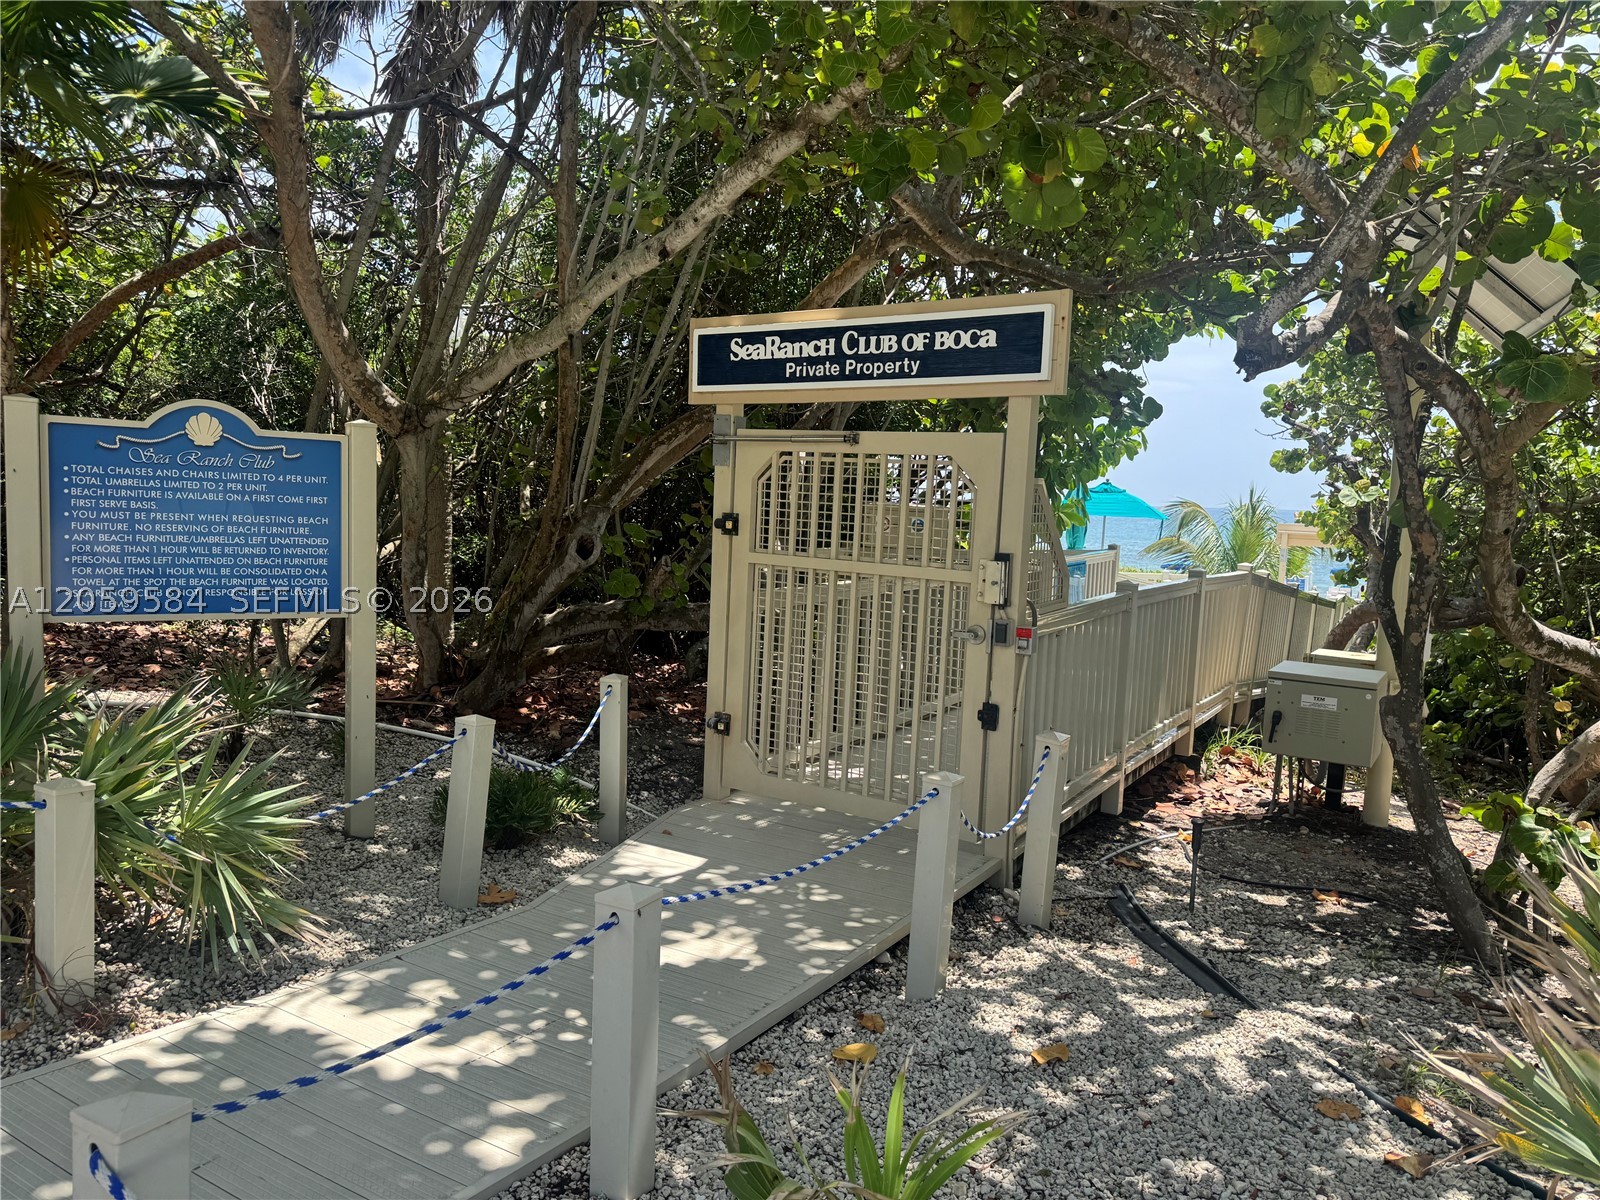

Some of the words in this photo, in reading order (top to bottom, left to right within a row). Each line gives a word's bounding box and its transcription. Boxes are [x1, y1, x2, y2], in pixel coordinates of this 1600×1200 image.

[902, 332, 931, 352] OF
[785, 361, 840, 378] Private
[845, 358, 920, 377] Property
[128, 447, 172, 464] Sea
[177, 450, 233, 467] Ranch
[238, 453, 275, 469] Club
[71, 464, 105, 474] TOTAL
[107, 466, 153, 476] CHAISES
[155, 469, 179, 477] AND
[182, 470, 219, 479] CHAIRS
[222, 472, 260, 481] LIMITED
[262, 474, 276, 482] TO
[286, 475, 302, 483] PER
[304, 476, 328, 484] UNIT.
[71, 476, 102, 485] TOTAL
[105, 478, 161, 488] UMBRELLAS
[164, 481, 200, 489] LIMITED
[202, 482, 215, 490] TO
[218, 482, 224, 490] 2
[227, 483, 242, 491] PER
[245, 484, 268, 492] UNIT.
[71, 488, 105, 497] BEACH
[108, 489, 162, 498] FURNITURE
[165, 491, 173, 499] IS
[175, 491, 224, 500] AVAILABLE
[226, 493, 241, 501] ON
[243, 494, 251, 502] A
[252, 494, 274, 503] FIRST
[277, 495, 304, 504] COME
[306, 496, 328, 505] FIRST
[71, 499, 96, 507] FIRST
[99, 500, 127, 508] SERVE
[130, 500, 159, 509] BASIS.
[72, 510, 96, 519] YOU
[100, 511, 131, 519] MUST
[134, 511, 146, 520] BE
[150, 512, 194, 521] PRESENT
[198, 514, 229, 522] WHEN
[232, 514, 294, 524] REQUESTING
[297, 516, 329, 525] BEACH
[71, 522, 132, 531] FURNITURE.
[135, 523, 152, 531] NO
[155, 524, 208, 533] RESERVING
[211, 525, 224, 533] OF
[227, 526, 258, 534] BEACH
[260, 526, 312, 535] FURNITURE.
[72, 533, 95, 541] ANY
[98, 534, 132, 542] BEACH
[136, 534, 245, 544] FURNITURE/UMBRELLAS
[270, 537, 329, 545] UNATTENDED
[71, 544, 91, 553] FOR
[93, 545, 121, 553] MORE
[123, 545, 149, 553] THAN
[160, 546, 187, 554] HOUR
[283, 547, 329, 555] INVENTORY.
[71, 556, 121, 564] PERSONAL
[124, 556, 150, 564] ITEMS
[175, 557, 234, 565] UNATTENDED
[236, 557, 252, 565] ON
[254, 557, 282, 565] BEACH
[72, 567, 92, 575] FOR
[95, 567, 124, 575] MORE
[127, 567, 154, 575] THAN
[233, 568, 302, 576] CONSOLIDATED
[72, 578, 106, 586] TOWEL
[107, 578, 120, 586] AT
[123, 578, 140, 586] THE
[143, 578, 167, 586] SPOT
[169, 578, 187, 586] THE
[189, 578, 218, 586] BEACH
[221, 578, 267, 586] FURNITURE
[270, 578, 288, 586] WAS
[291, 578, 329, 586] LOCATED.
[73, 589, 92, 597] SA
